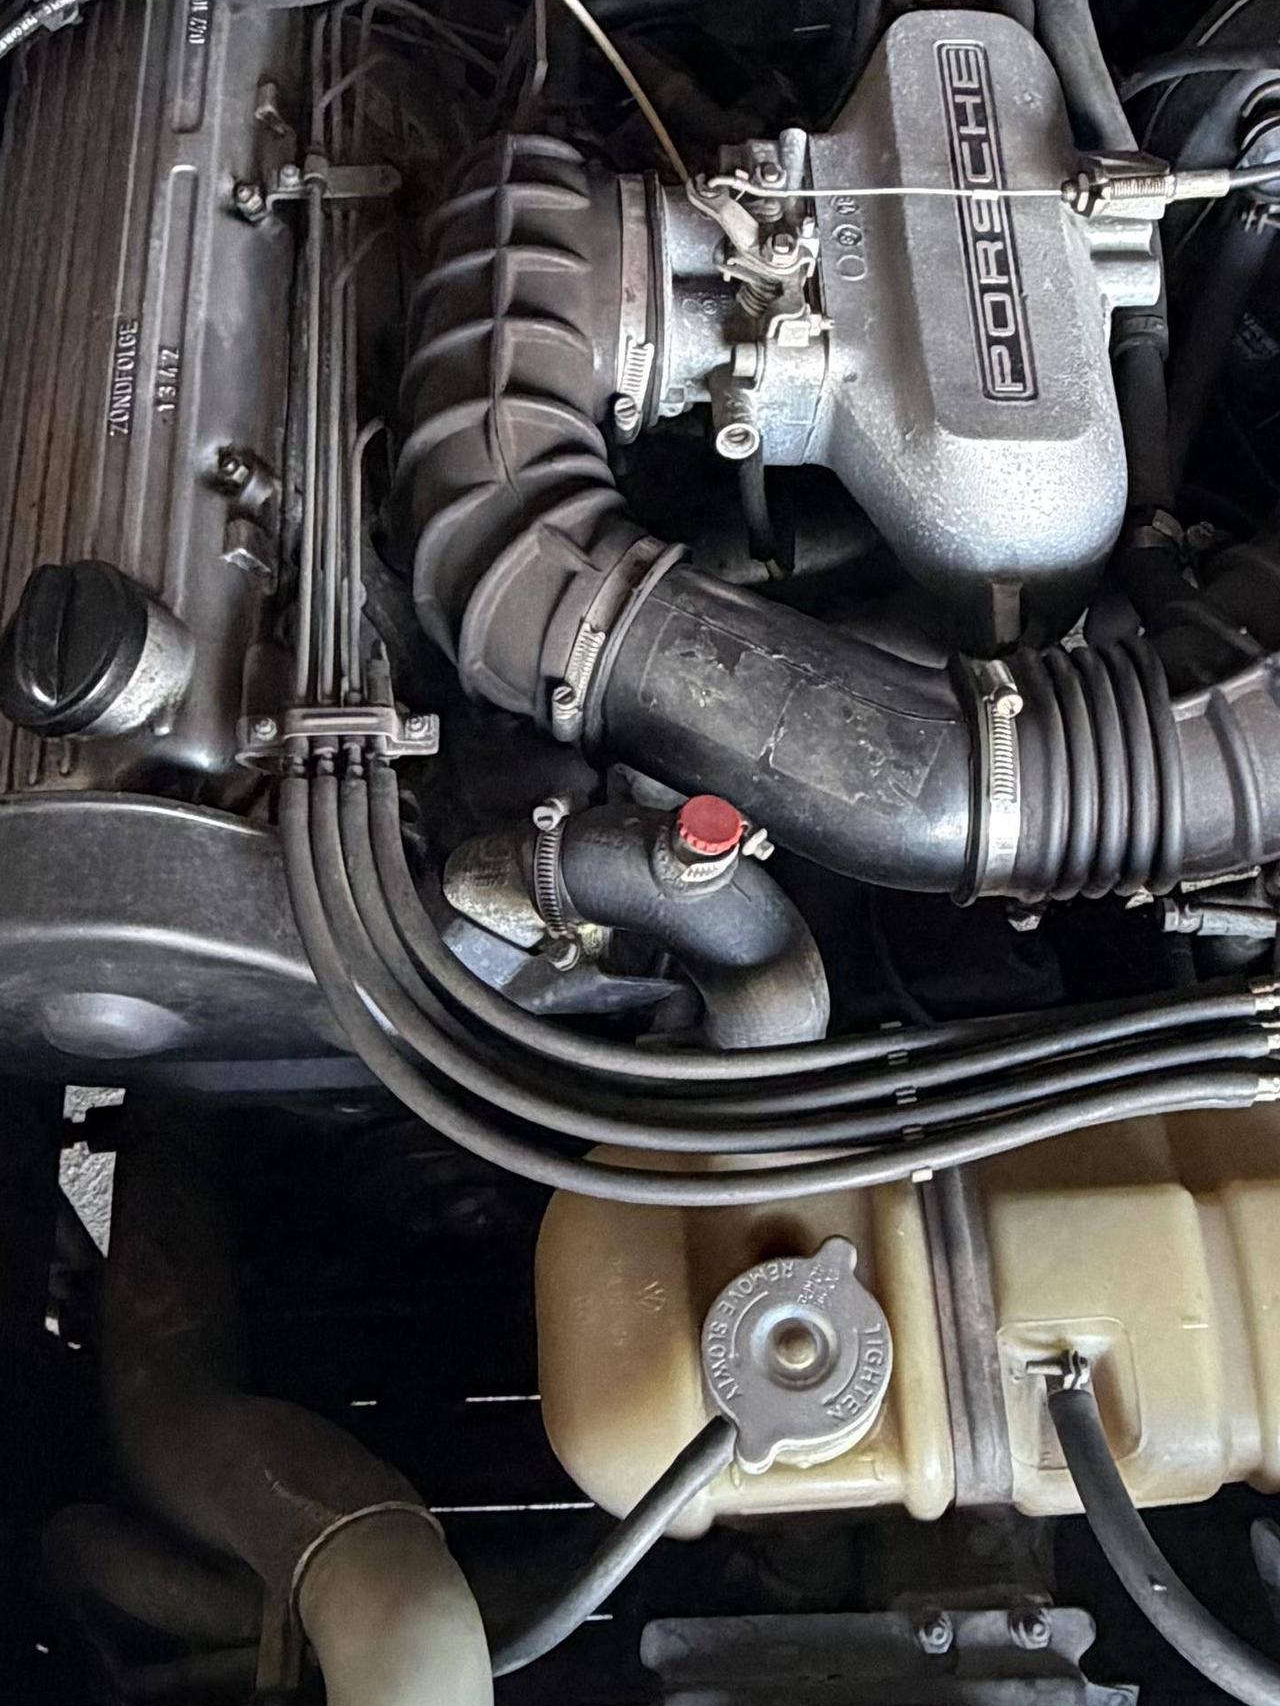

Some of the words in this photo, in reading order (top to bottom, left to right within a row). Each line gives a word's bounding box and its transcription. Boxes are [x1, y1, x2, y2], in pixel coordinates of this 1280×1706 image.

[945, 46, 1028, 394] PORSCHE
[718, 1261, 797, 1317] REMOVE
[706, 1320, 744, 1402] SLOWLY
[825, 1322, 886, 1423] TIGHTEN
